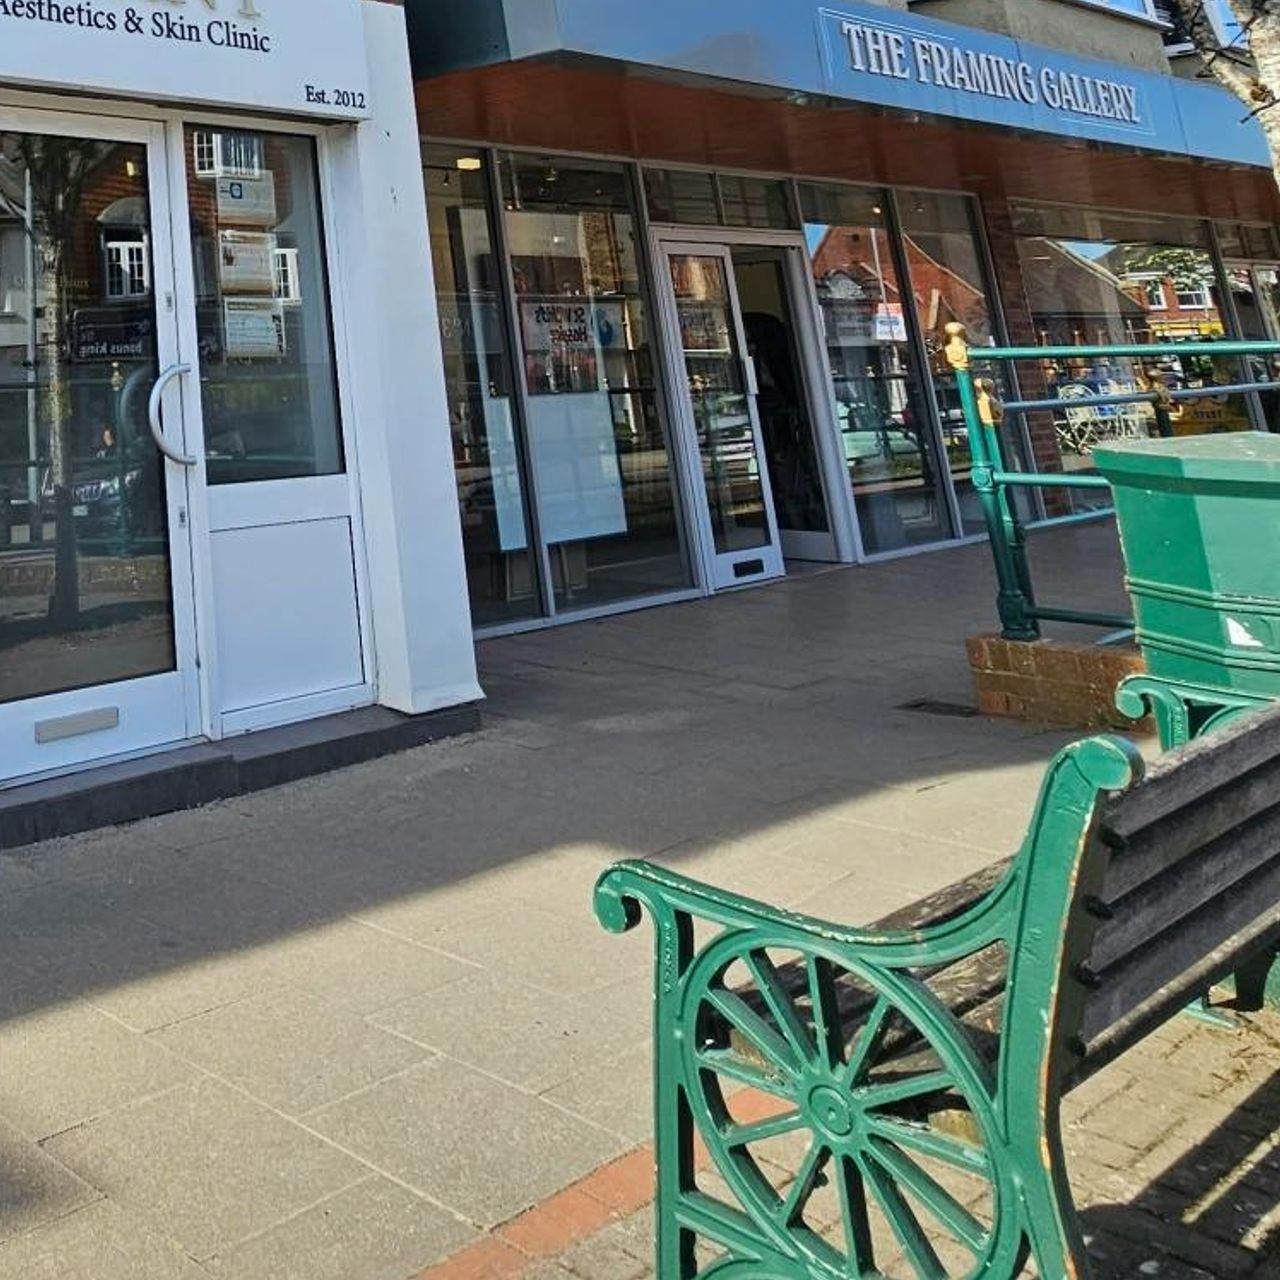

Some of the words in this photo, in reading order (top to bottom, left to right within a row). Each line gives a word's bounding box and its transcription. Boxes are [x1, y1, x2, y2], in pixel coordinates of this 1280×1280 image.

[124, 7, 145, 35] &
[151, 11, 202, 43] Skin
[207, 20, 271, 54] Clinic
[841, 20, 910, 80] THE
[912, 37, 1035, 106] FRAMING
[1040, 67, 1142, 124] GALLERY
[305, 84, 331, 104] Est.
[334, 89, 366, 109] 2012
